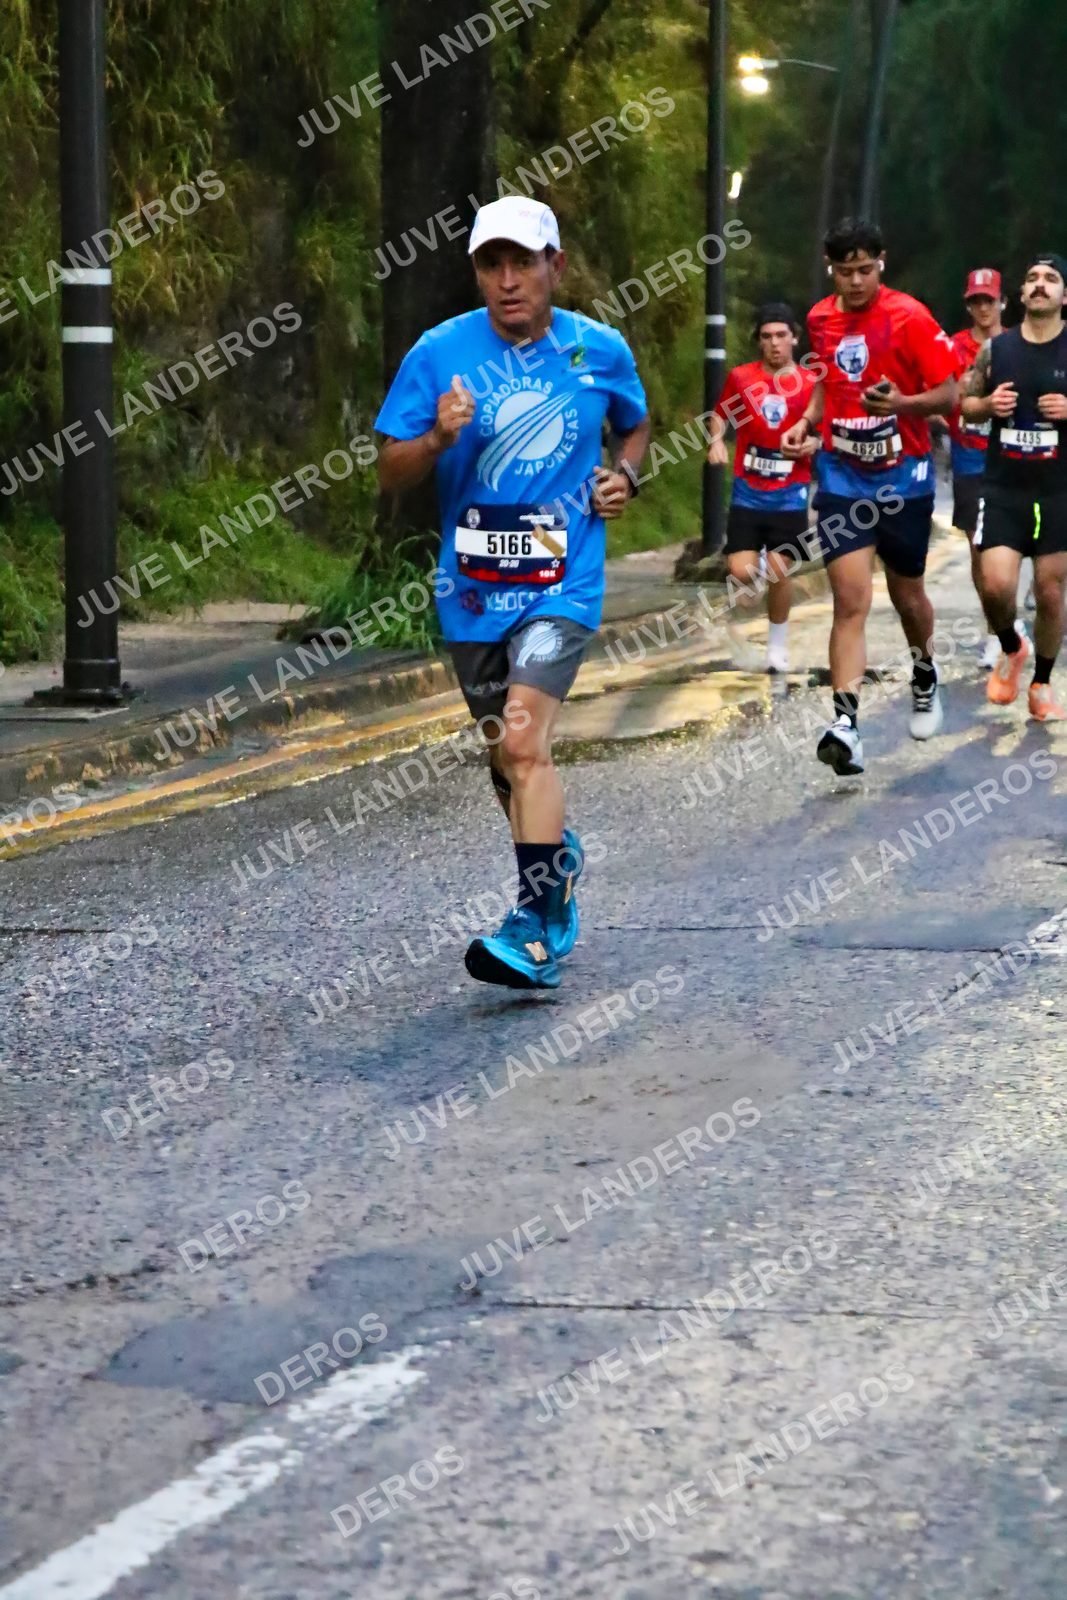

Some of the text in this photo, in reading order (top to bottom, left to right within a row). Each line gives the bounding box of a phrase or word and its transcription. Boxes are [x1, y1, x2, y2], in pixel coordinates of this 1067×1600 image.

[480, 376, 553, 437] COPIADORAS
[515, 408, 579, 476] JAPONESAS
[487, 534, 532, 555] 5166
[539, 570, 556, 578] 10K
[485, 582, 562, 612] KYOC
